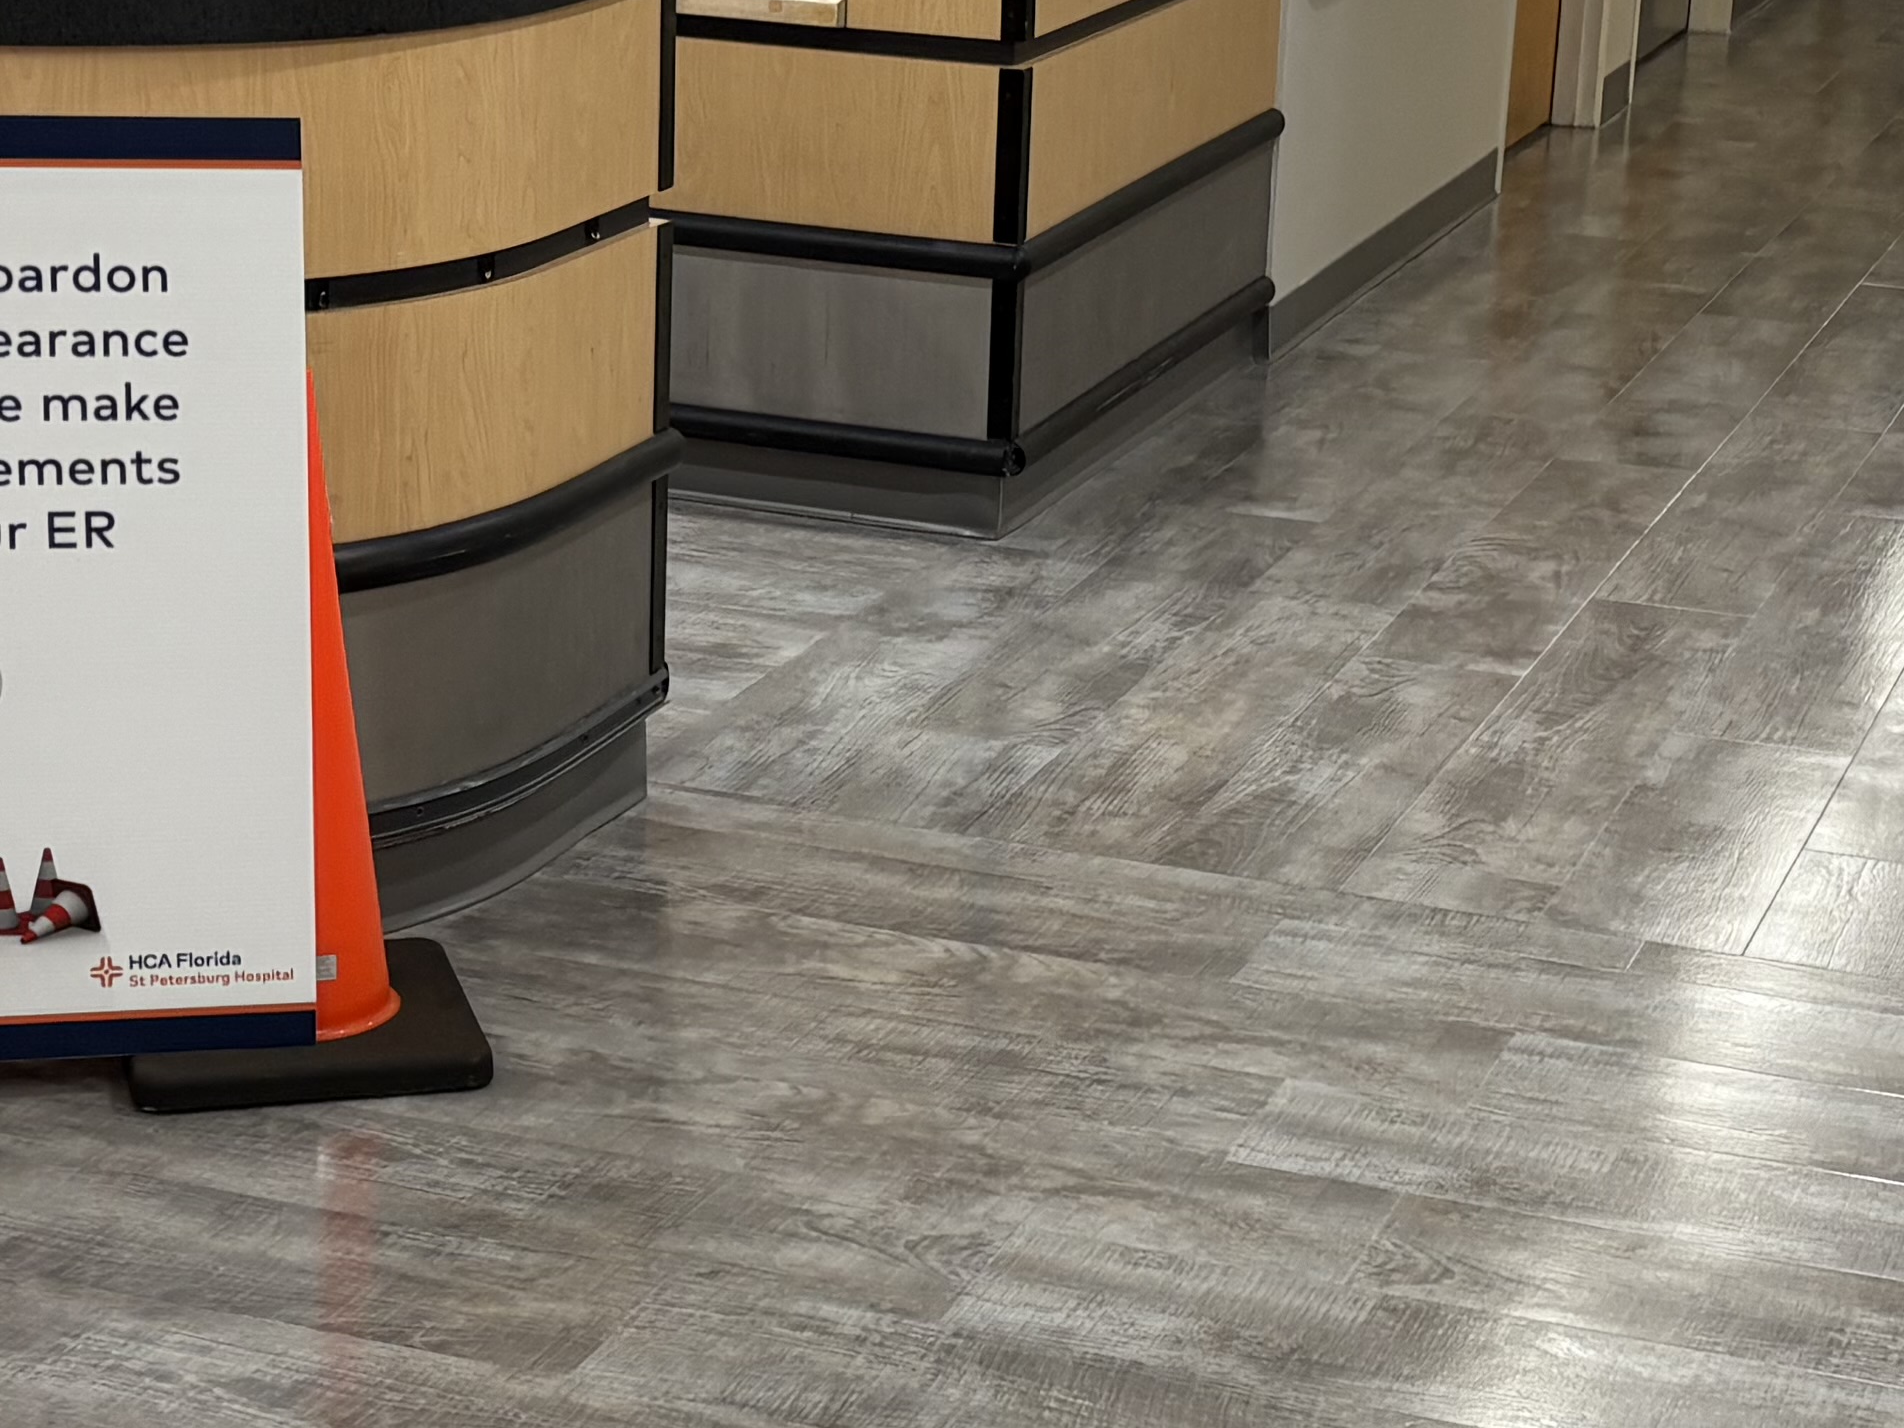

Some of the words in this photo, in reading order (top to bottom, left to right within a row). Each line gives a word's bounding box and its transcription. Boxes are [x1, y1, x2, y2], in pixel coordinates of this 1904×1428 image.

[42, 381, 180, 422] make
[47, 510, 116, 550] ER
[129, 953, 172, 970] HCA
[176, 950, 242, 969] Florida
[129, 974, 145, 988] St
[150, 971, 230, 987] Petersburg
[234, 968, 294, 984] Hospital
